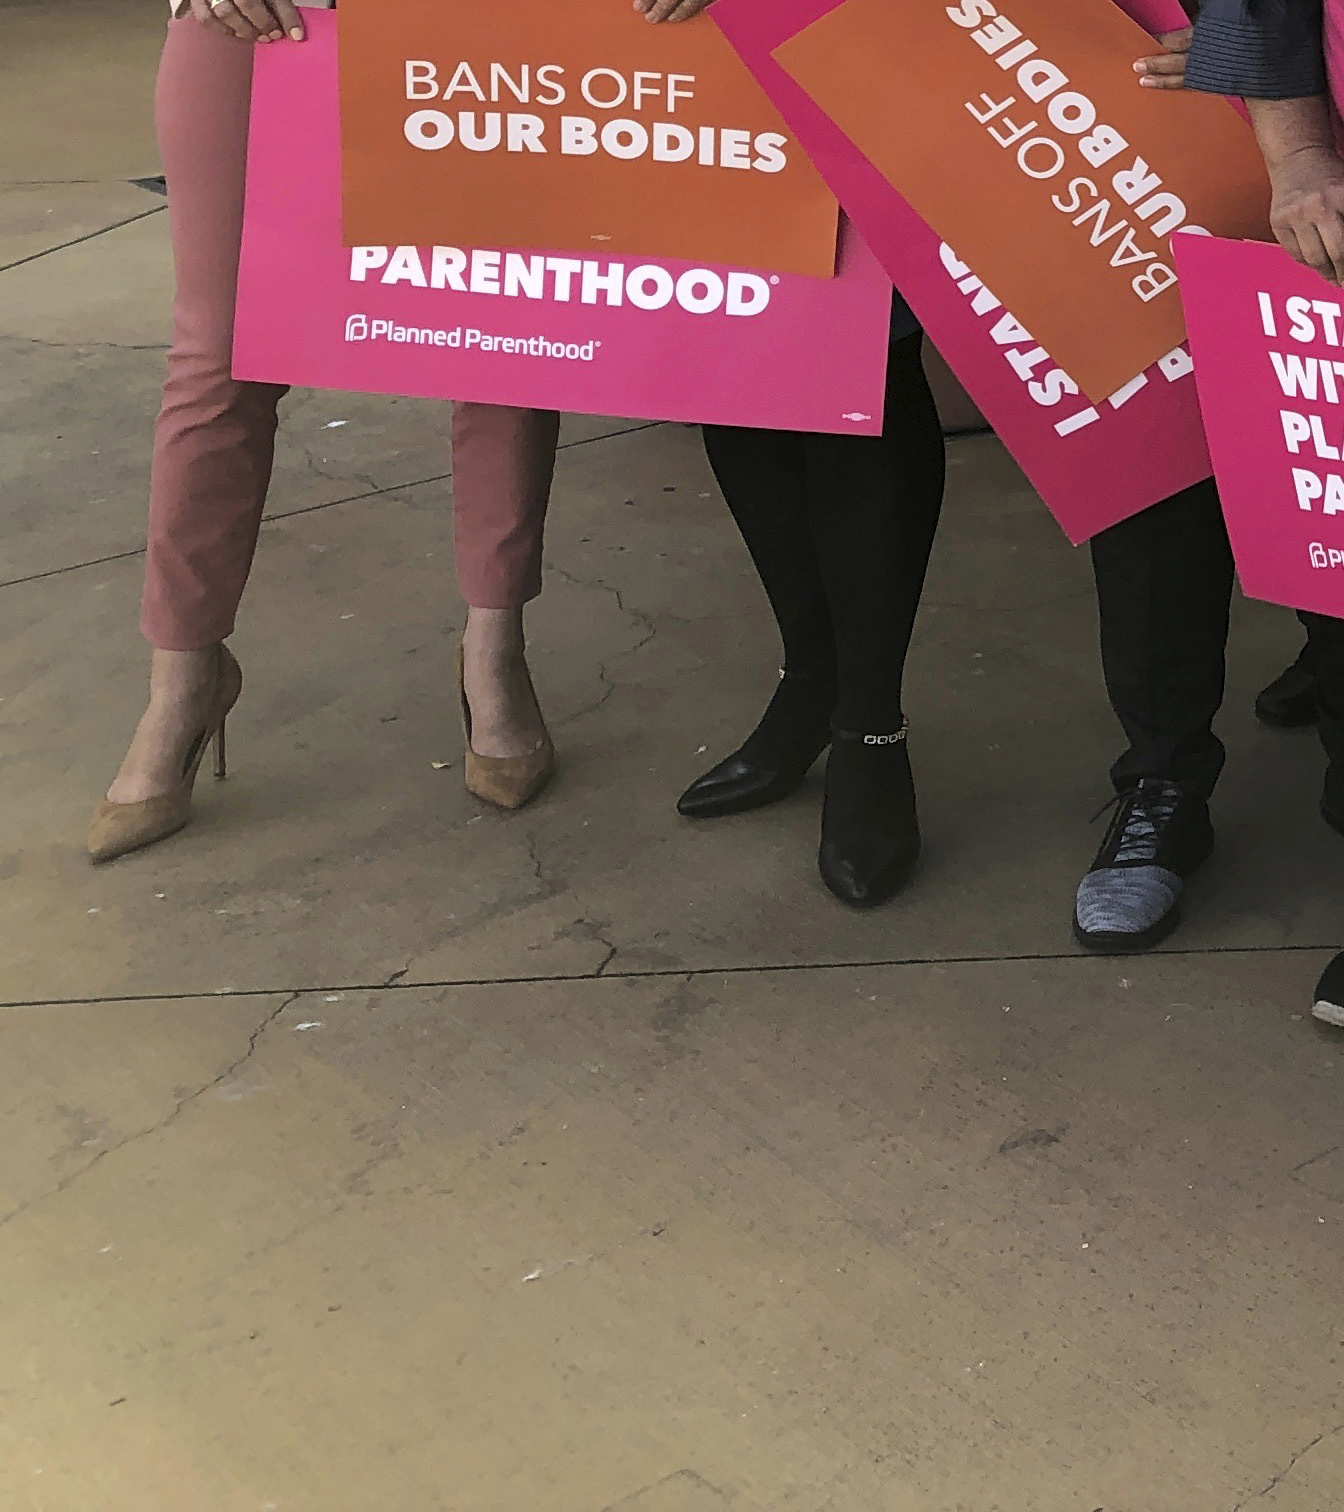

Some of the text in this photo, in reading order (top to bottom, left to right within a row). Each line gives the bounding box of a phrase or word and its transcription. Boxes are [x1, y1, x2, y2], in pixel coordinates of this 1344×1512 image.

[404, 60, 695, 113] BANS OFF
[403, 110, 788, 174] OUR BODIES
[964, 92, 1178, 303] BANS OFF
[1112, 155, 1213, 258] UR
[349, 245, 771, 317] PARENTHOOD
[370, 319, 594, 362] Planned Parenthood
[1257, 291, 1276, 338] I
